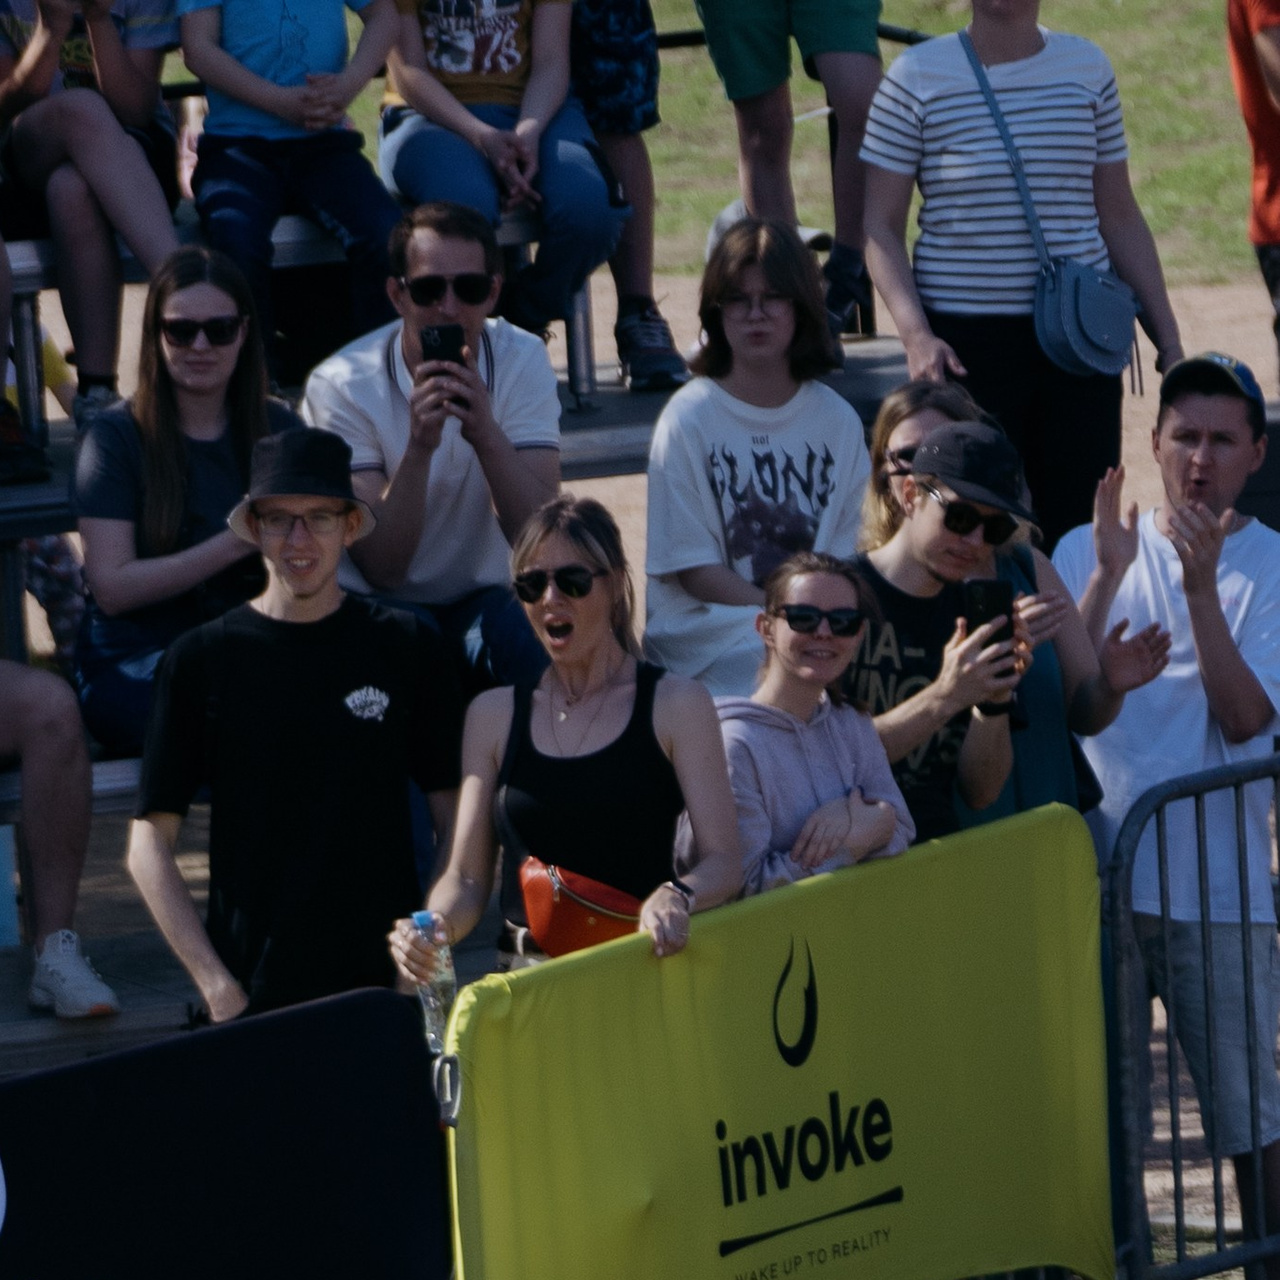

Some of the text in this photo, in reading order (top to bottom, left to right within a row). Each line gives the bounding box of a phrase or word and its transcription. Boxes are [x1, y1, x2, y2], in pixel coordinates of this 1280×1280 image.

[714, 1089, 893, 1208] invoke
[783, 1254, 803, 1275] UP
[808, 1248, 828, 1267] TO
[831, 1227, 892, 1260] REALITY
